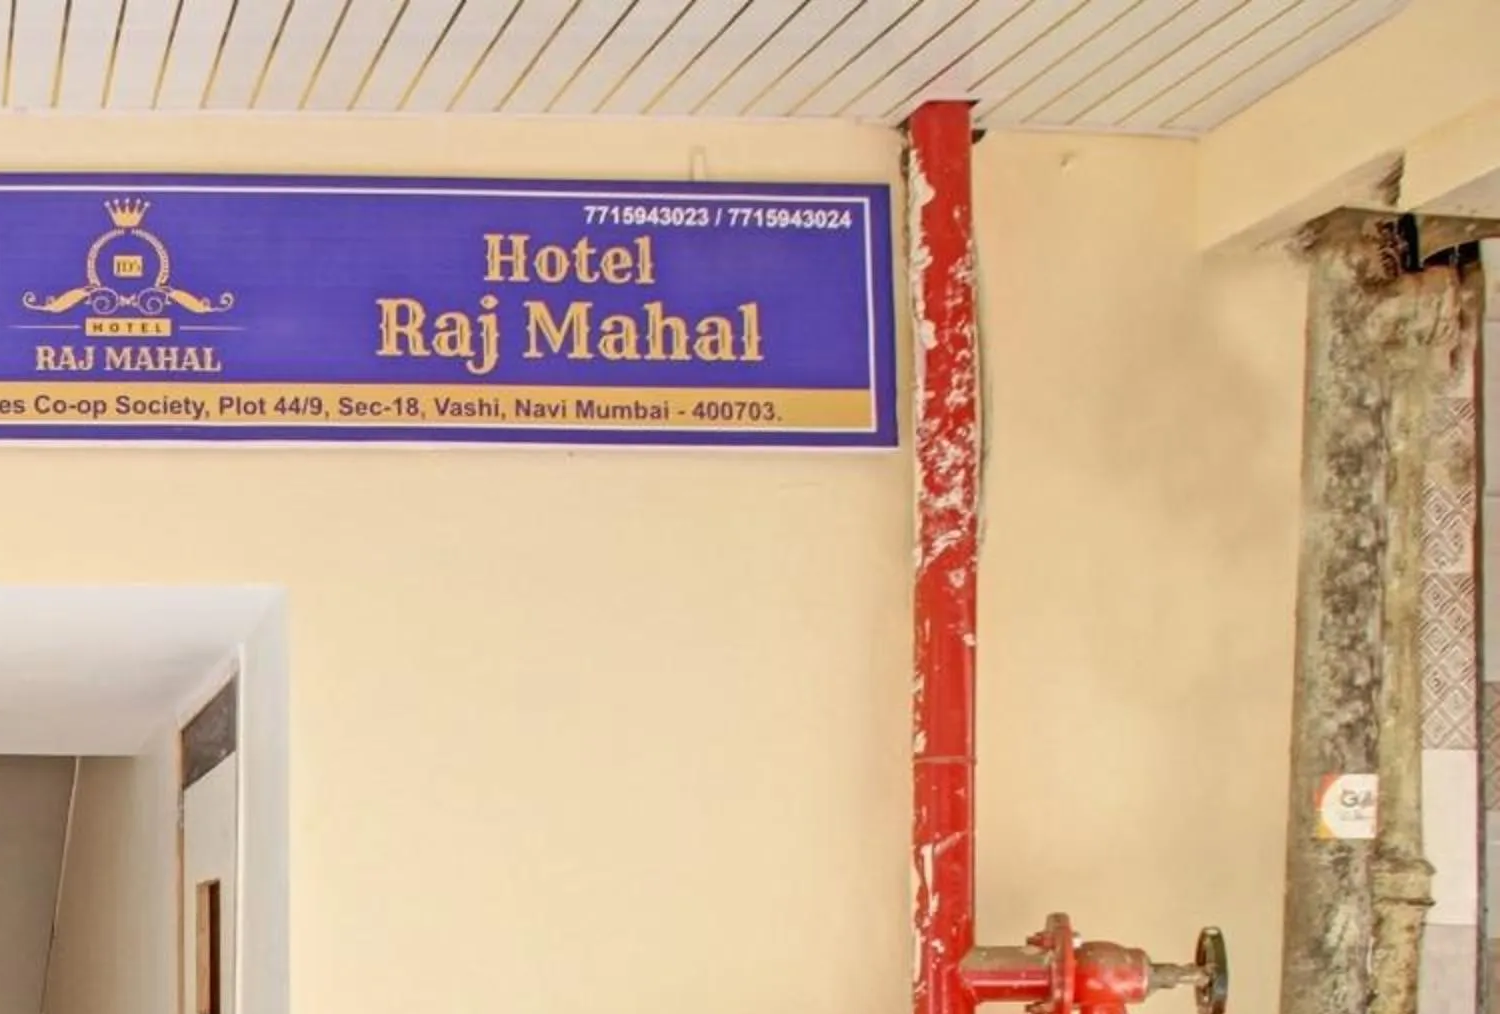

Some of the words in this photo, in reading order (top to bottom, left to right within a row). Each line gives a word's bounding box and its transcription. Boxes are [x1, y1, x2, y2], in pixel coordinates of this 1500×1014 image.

[583, 205, 709, 227] 7715943023
[714, 208, 722, 226] /
[727, 208, 853, 229] 7715943024
[483, 233, 655, 284] Hotel
[92, 321, 164, 334] HOTEL
[376, 295, 498, 375] Raj
[523, 300, 764, 361] Mahal
[35, 345, 94, 371] RAJ
[105, 346, 221, 372] MAHAL
[33, 395, 107, 420] Co-op
[115, 395, 210, 420] Society,
[219, 396, 266, 416] Plot
[274, 397, 330, 419] 44/9,
[338, 397, 427, 420] Sec-18,
[434, 398, 507, 420] Vashi,
[515, 399, 567, 420] Navi
[575, 400, 670, 421] Mumbai
[692, 401, 783, 422] 400703.
